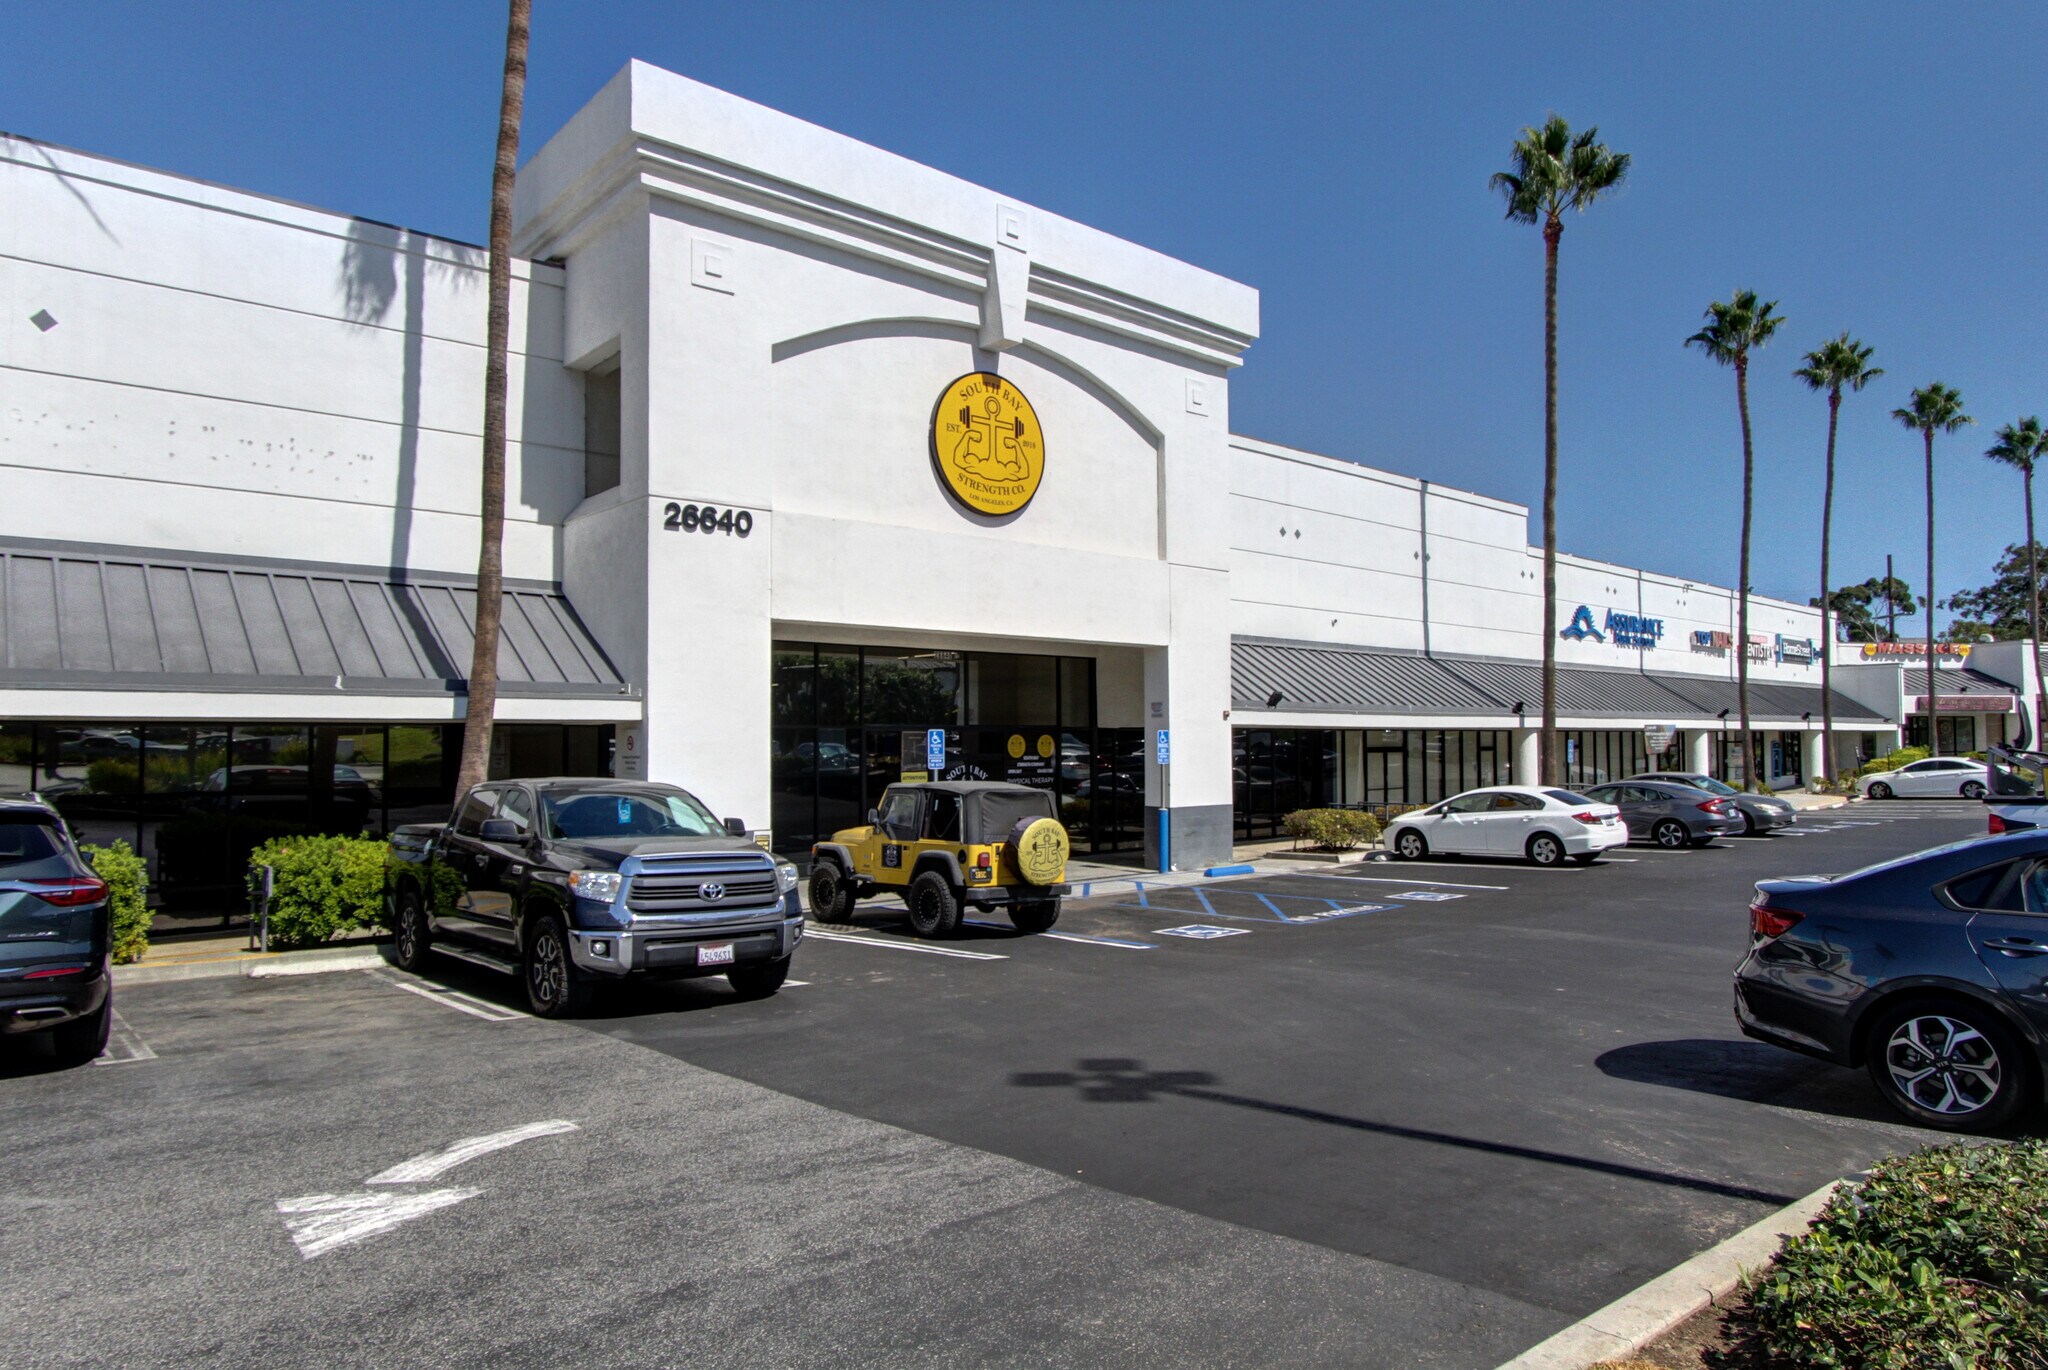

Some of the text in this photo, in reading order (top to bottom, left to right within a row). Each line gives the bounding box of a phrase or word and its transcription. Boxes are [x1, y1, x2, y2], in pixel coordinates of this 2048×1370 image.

[959, 381, 1024, 411] SOUTH BAY
[957, 473, 1026, 496] STRENGTH CO.
[969, 493, 980, 501] LOS
[664, 502, 753, 537] 26640
[1604, 608, 1665, 638] ASSURANCE
[1694, 630, 1711, 647] TOP
[1747, 643, 1773, 659] ENTISTRY
[973, 766, 989, 780] BAY
[1007, 777, 1031, 785] PHYSICAL
